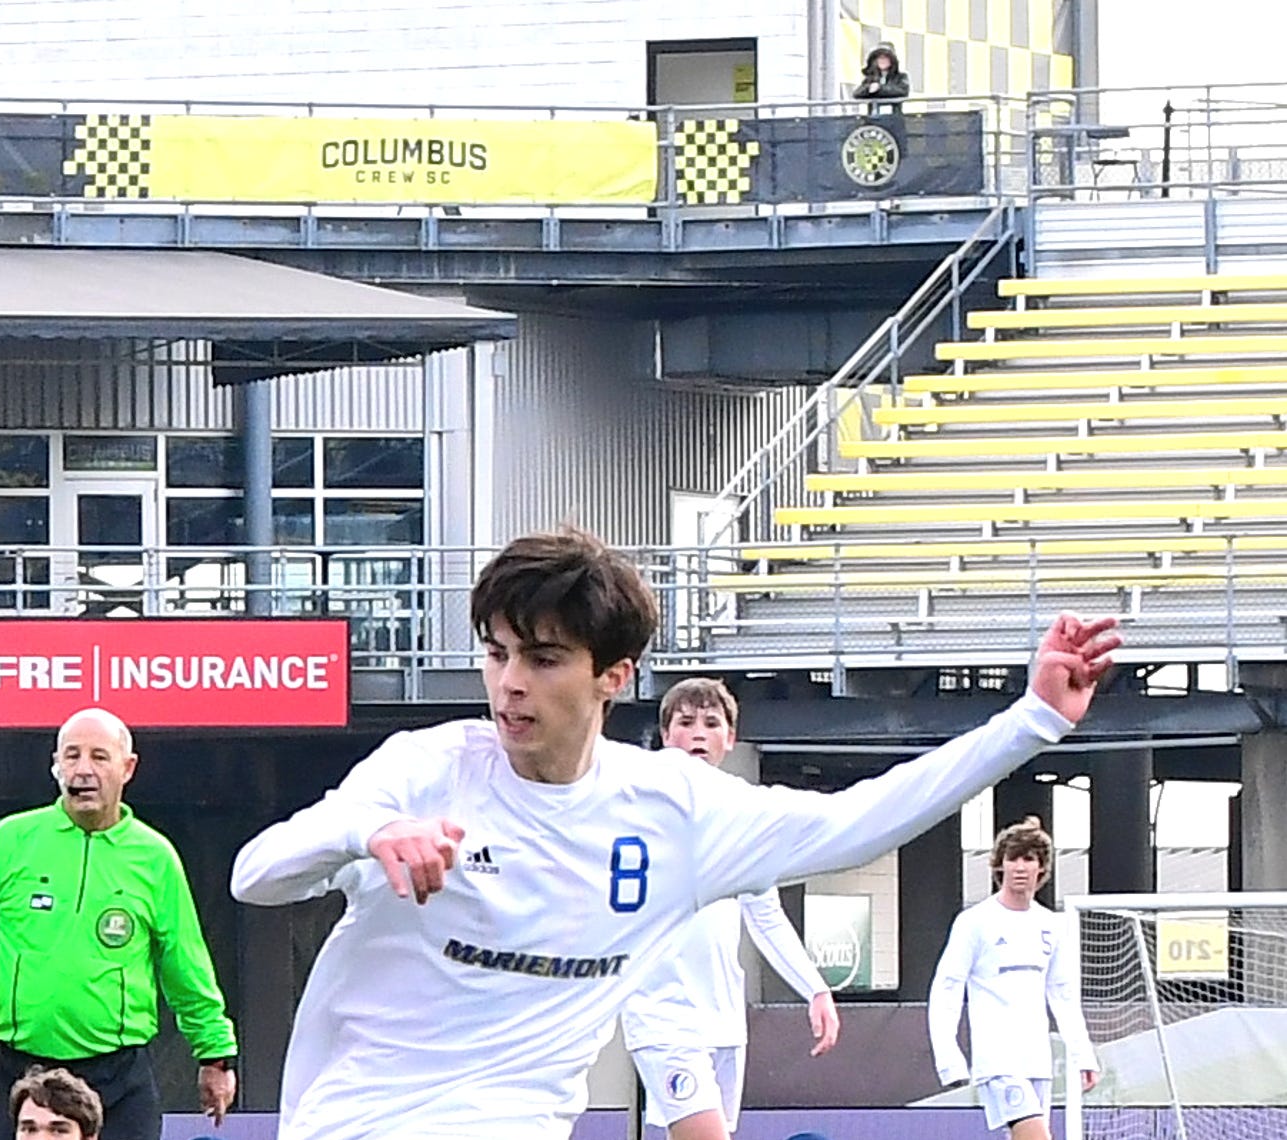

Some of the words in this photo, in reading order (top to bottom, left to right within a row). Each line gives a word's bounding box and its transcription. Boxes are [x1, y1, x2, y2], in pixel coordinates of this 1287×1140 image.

[322, 138, 487, 171] COLUMBUS
[355, 170, 415, 183] CREW
[426, 170, 451, 184] SC
[111, 656, 328, 690] INSURANCE
[609, 835, 650, 913] 8
[443, 938, 630, 979] MARIEMONT
